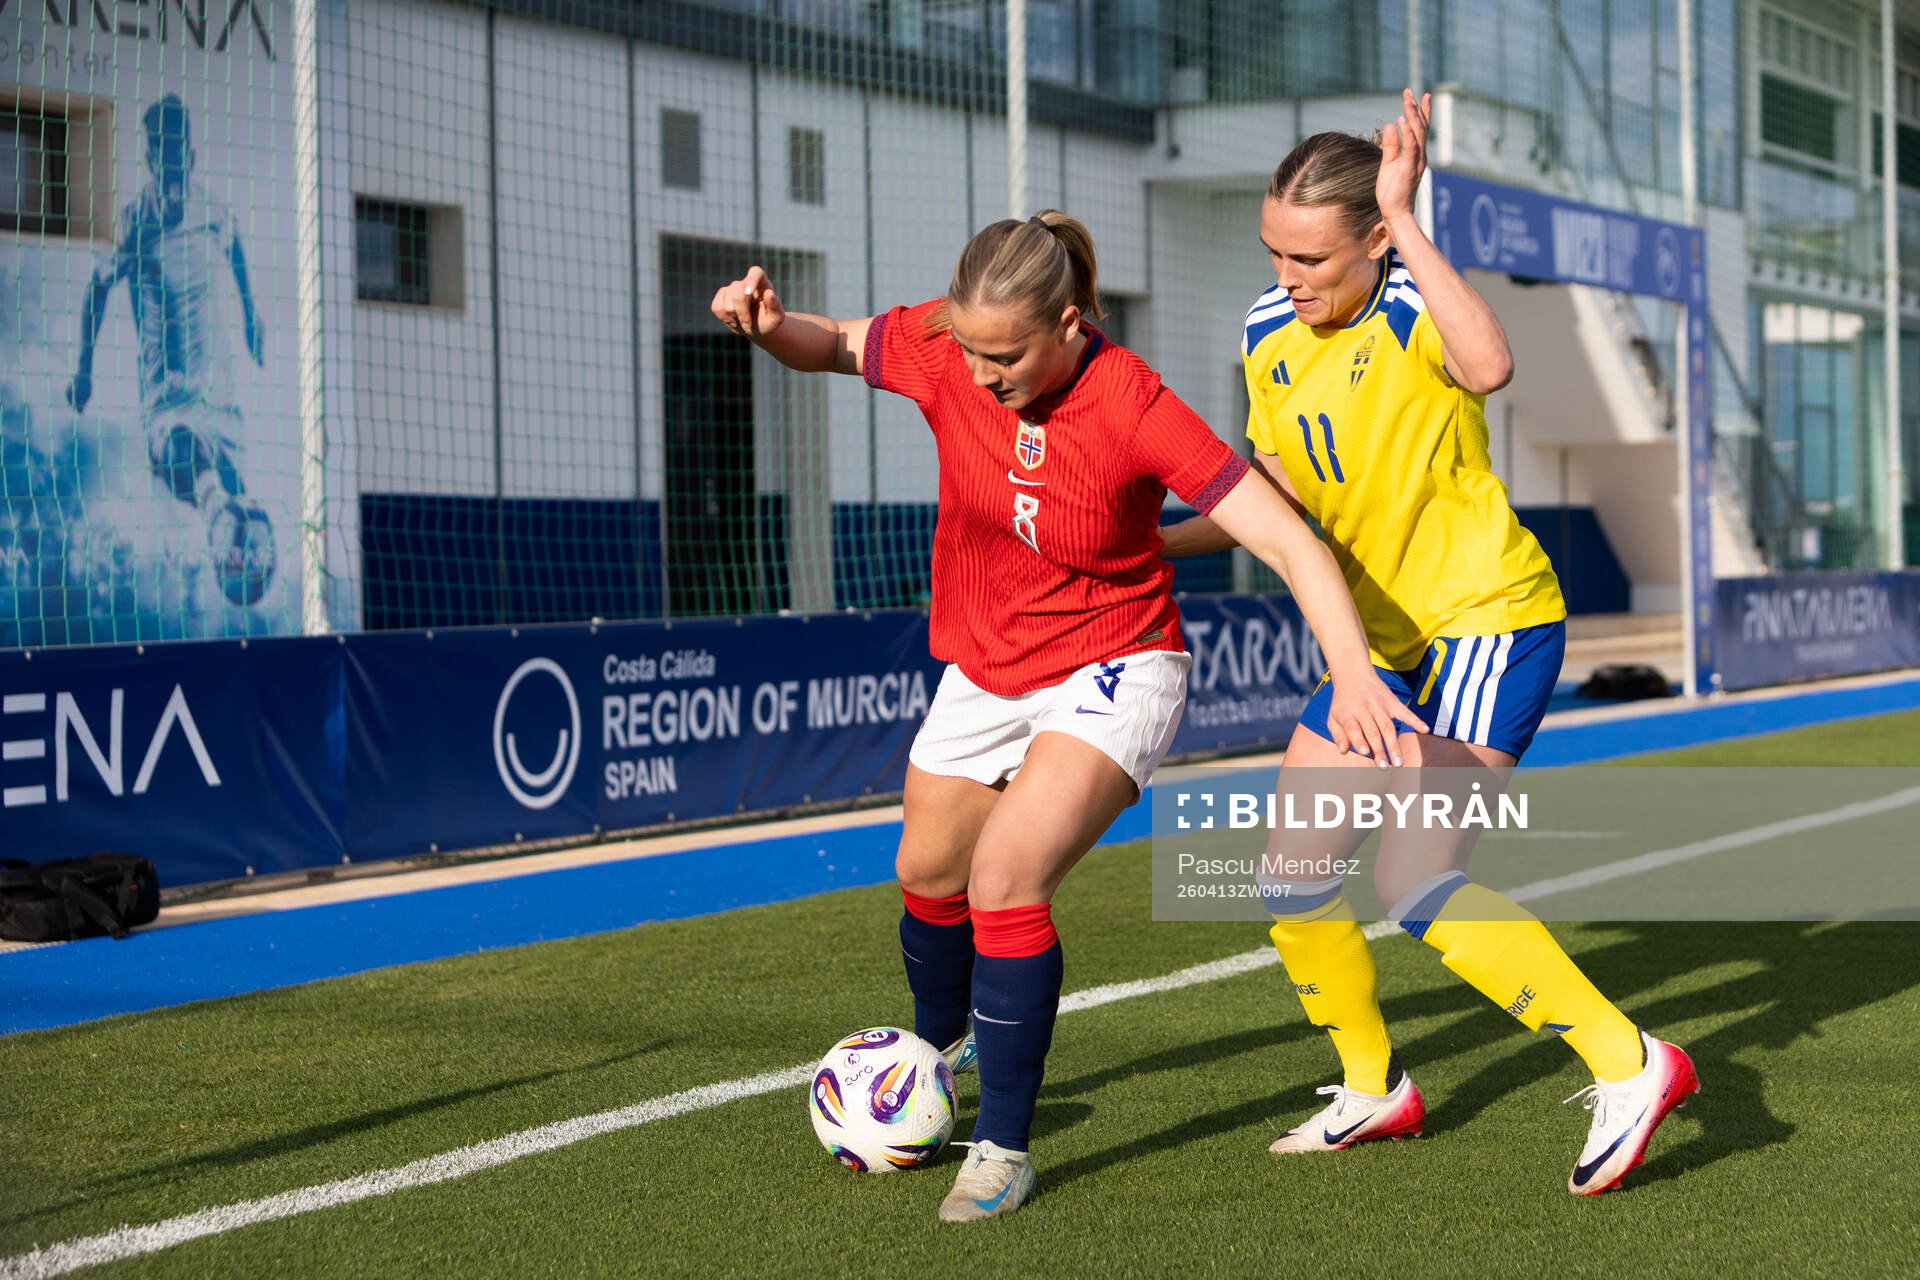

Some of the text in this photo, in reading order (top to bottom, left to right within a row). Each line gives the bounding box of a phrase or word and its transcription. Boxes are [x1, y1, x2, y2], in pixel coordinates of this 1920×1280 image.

[1298, 412, 1345, 484] 11
[1012, 491, 1041, 556] 8
[603, 649, 716, 686] Costa Cálida
[602, 671, 930, 750] REGION OF MURCIA
[604, 755, 678, 802] SPAIN
